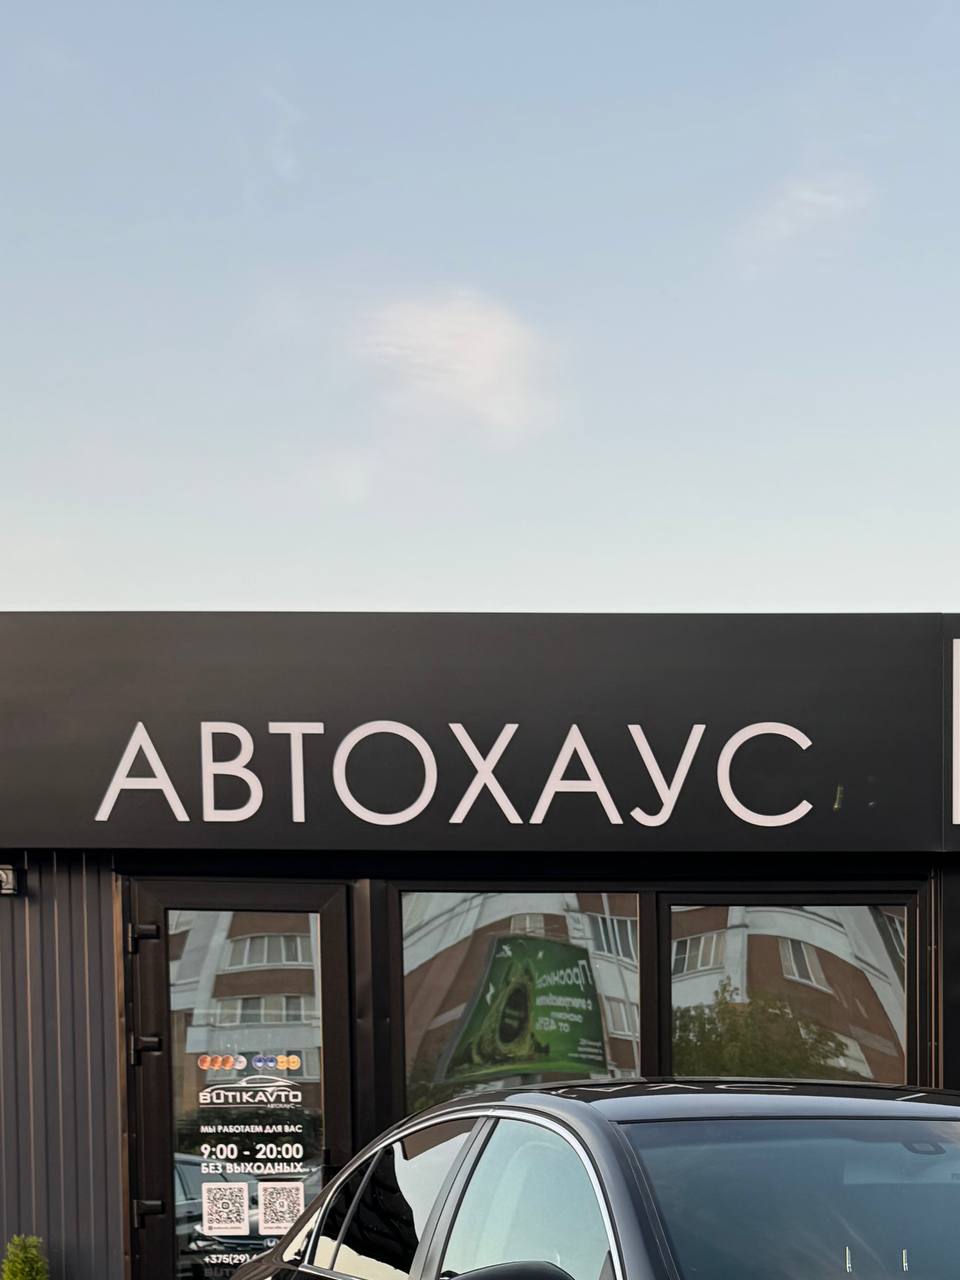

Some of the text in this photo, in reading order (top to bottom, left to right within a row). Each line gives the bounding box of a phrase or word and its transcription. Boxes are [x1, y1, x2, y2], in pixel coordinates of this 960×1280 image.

[95, 720, 813, 827] АВТОХАУС
[199, 1090, 302, 1103] BUTIKAVTO
[200, 1125, 303, 1133] МЫ РАБОТАЕМ ДЛЯ ВАС
[200, 1144, 238, 1160] 9:00
[255, 1143, 304, 1159] 20:00
[201, 1162, 304, 1175] БЕЗ ВЫХОДНЫХ
[203, 1253, 249, 1265] +375(29)
